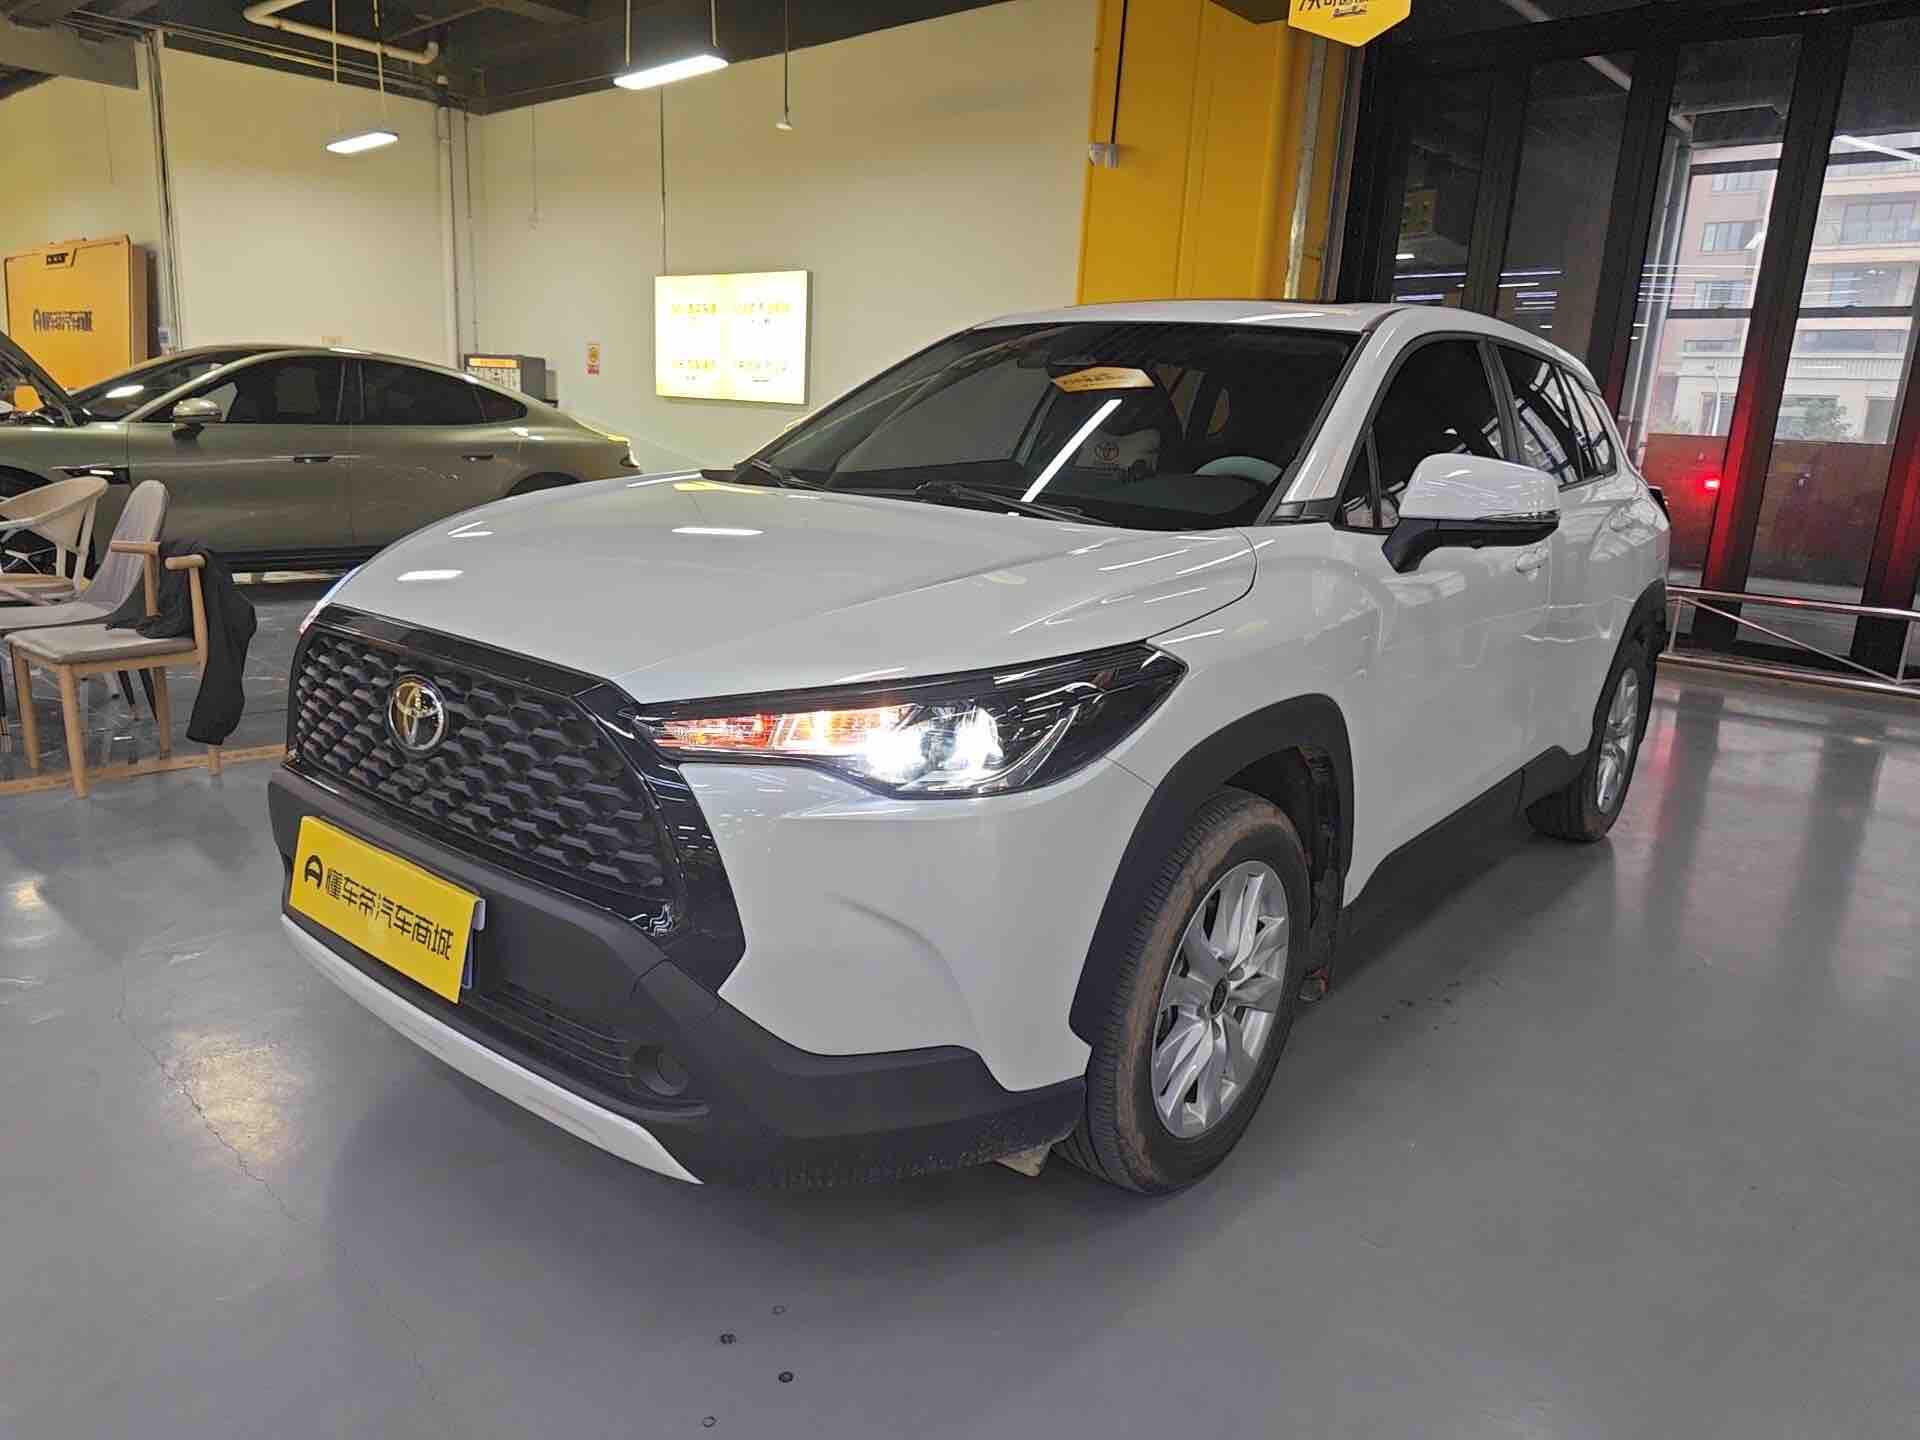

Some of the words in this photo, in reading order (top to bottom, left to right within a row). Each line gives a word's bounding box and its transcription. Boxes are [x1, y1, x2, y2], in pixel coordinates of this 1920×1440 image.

[325, 867, 454, 961] 懂车帝汽车商城
